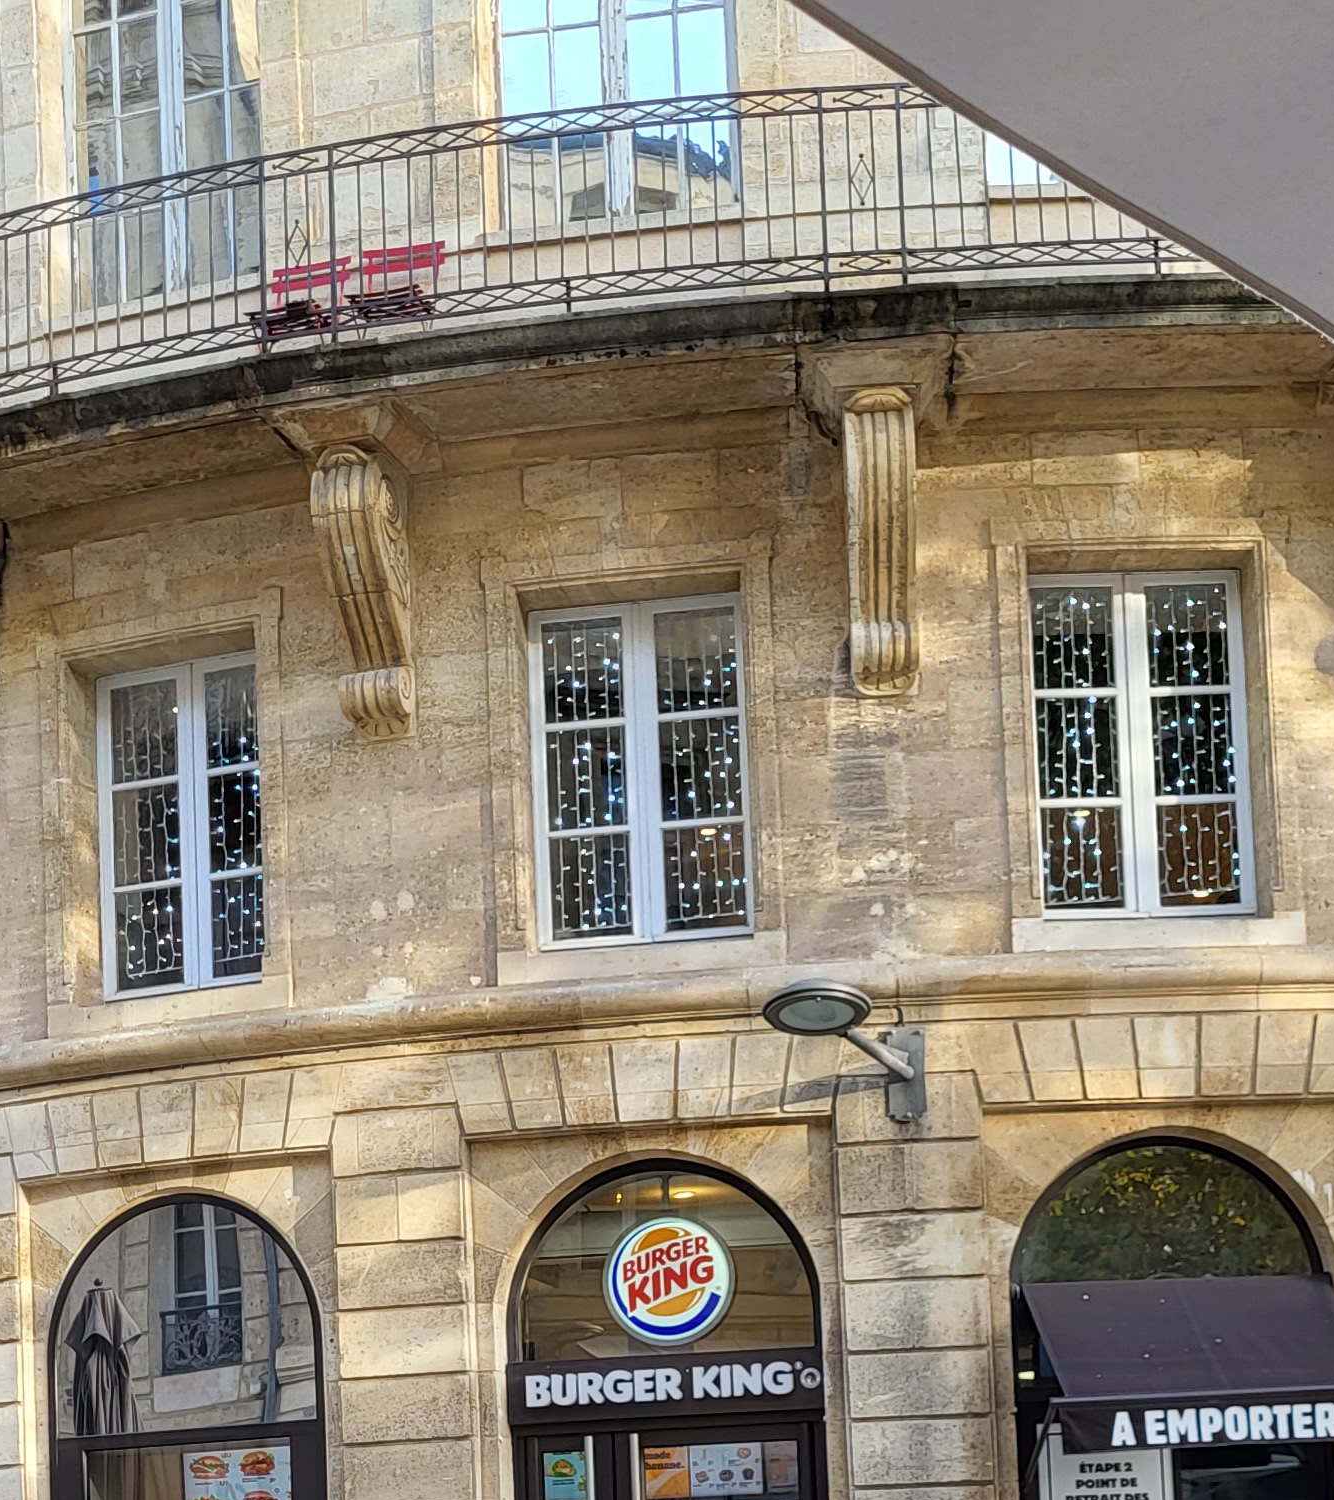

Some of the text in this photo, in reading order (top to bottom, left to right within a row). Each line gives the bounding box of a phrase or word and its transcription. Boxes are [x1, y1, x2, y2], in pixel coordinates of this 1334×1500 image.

[623, 1236, 709, 1284] BURGER
[628, 1255, 714, 1312] KING
[524, 1361, 795, 1408] BURGER KING
[1111, 1411, 1137, 1447] A
[1076, 1477, 1138, 1489] POINT DE
[1079, 1461, 1133, 1473] ÉTAPE 2
